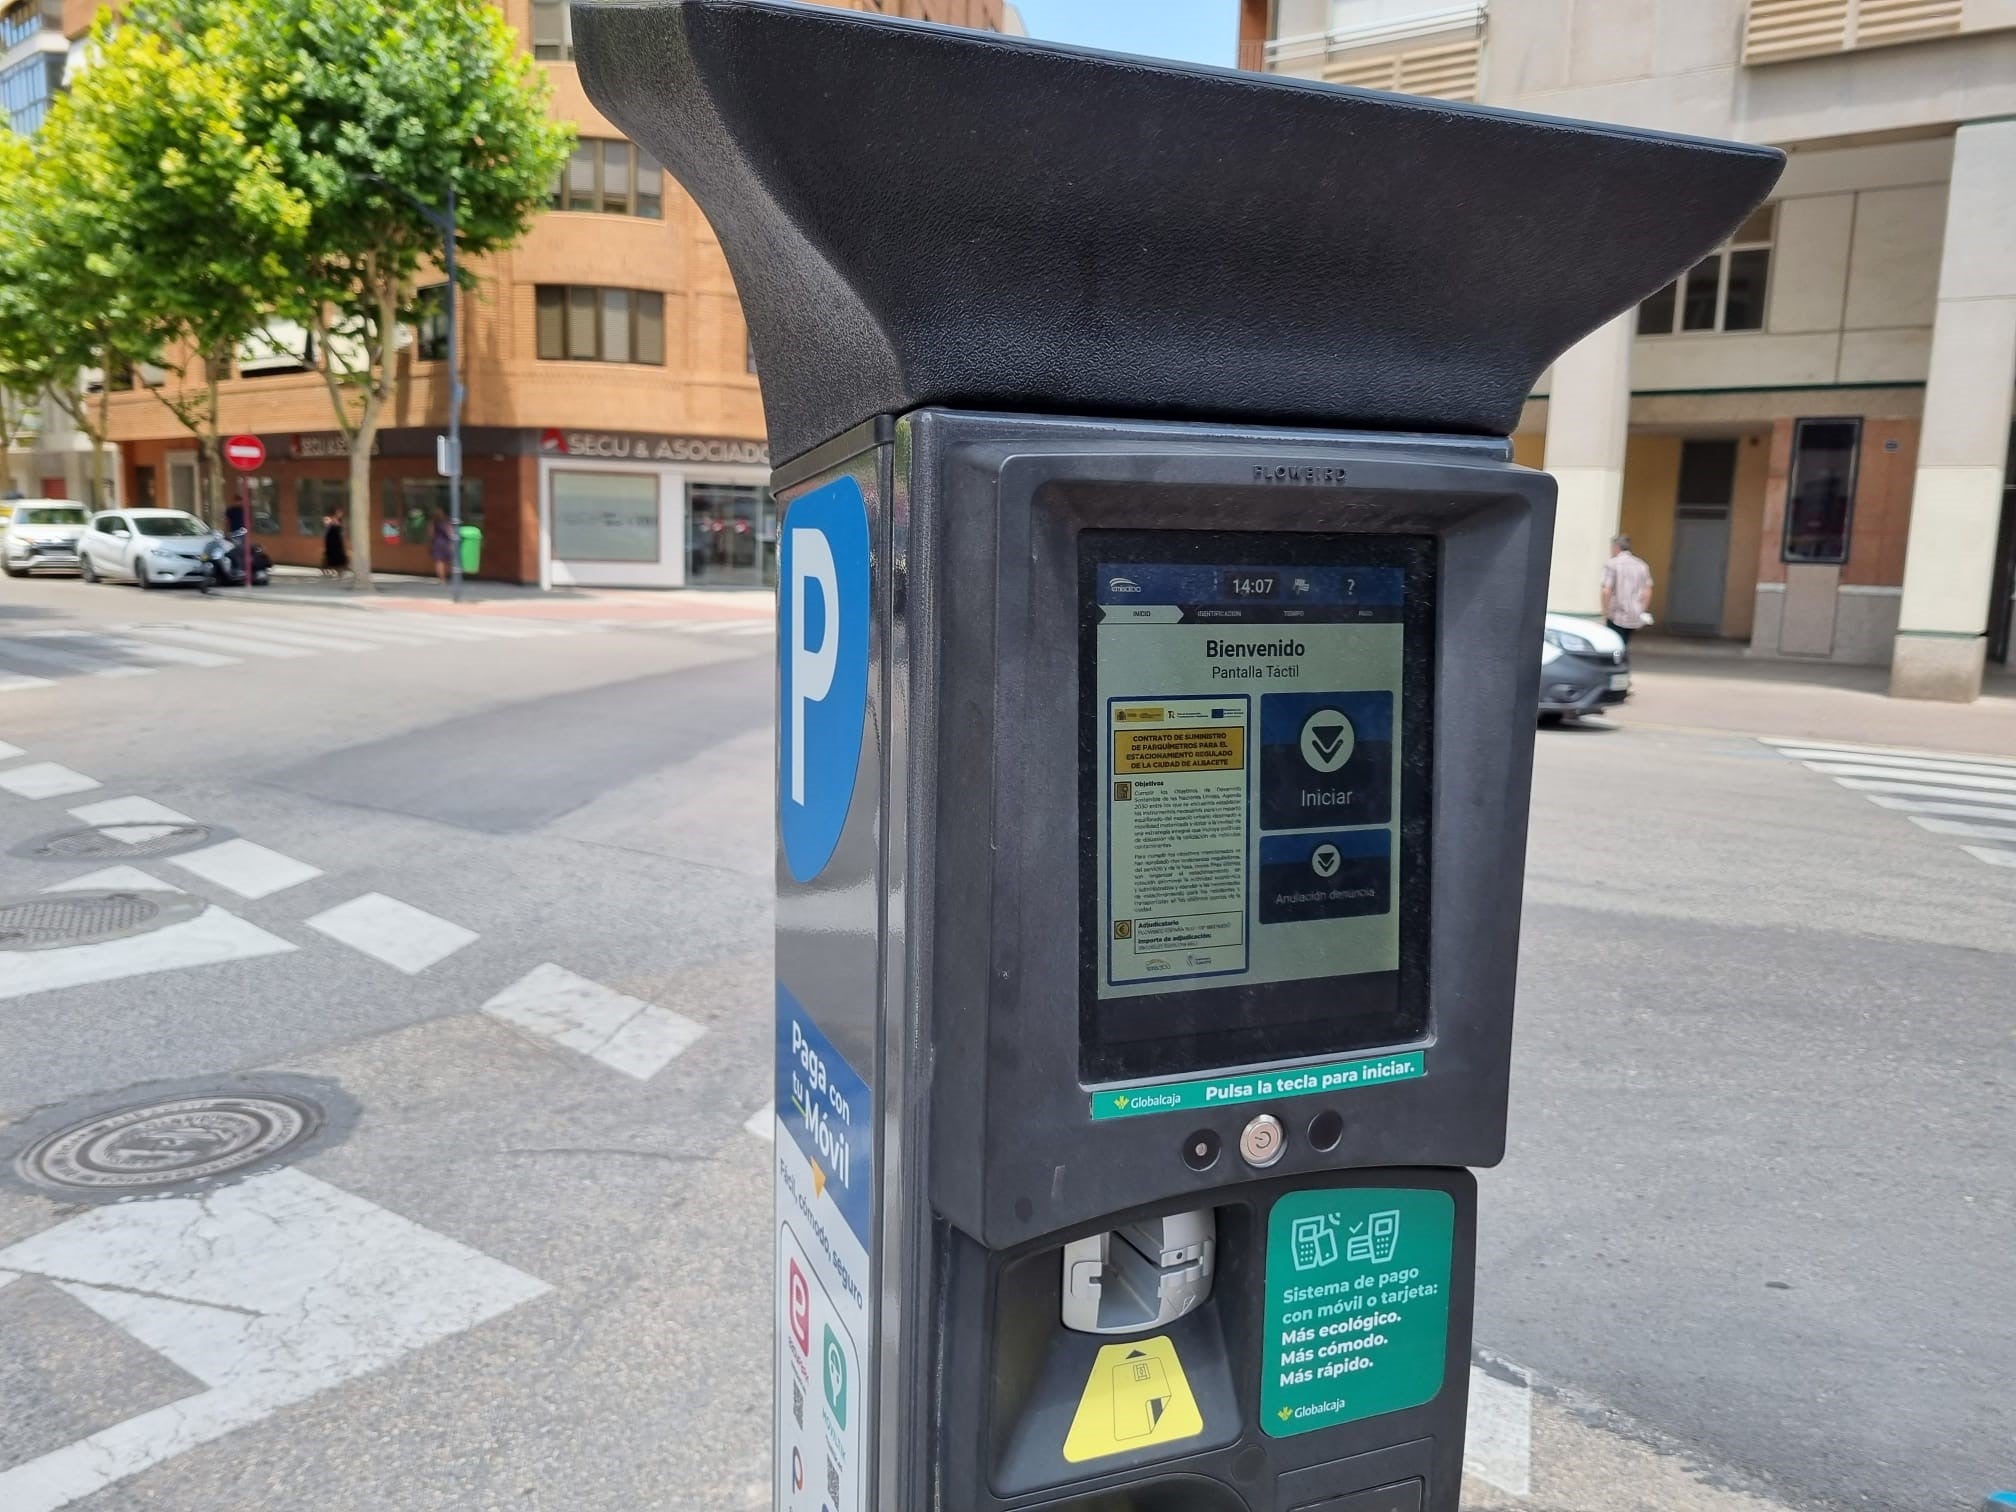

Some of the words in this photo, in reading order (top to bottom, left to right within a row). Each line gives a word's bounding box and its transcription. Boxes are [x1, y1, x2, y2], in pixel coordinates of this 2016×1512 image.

[567, 433, 630, 458] SECU
[633, 438, 650, 459] &
[1232, 578, 1274, 595] 14:07
[1206, 639, 1305, 658] Bienvenido
[792, 528, 840, 807] P
[1212, 665, 1263, 680] Pantalla
[1266, 664, 1300, 678] Táctil
[1126, 752, 1194, 761] ESTACIONAMIENTO
[1195, 750, 1233, 758] REGULADO
[1192, 759, 1229, 767] ALBACETE
[1301, 788, 1353, 807] Iniciar
[792, 1019, 827, 1095] Paga
[829, 1083, 850, 1126] con
[1205, 1086, 1253, 1101] Pulsa
[1257, 1081, 1274, 1095] la
[1276, 1076, 1318, 1092] tecla
[1321, 1071, 1359, 1090] para
[1362, 1060, 1416, 1081] iniciar.
[1130, 1092, 1181, 1110] Globalcaja
[792, 1070, 804, 1101] tu
[804, 1089, 849, 1190] Móvil
[798, 1193, 832, 1262] cómodo,
[832, 1250, 863, 1311] seguro
[1283, 1281, 1350, 1304] Sistema
[1354, 1275, 1375, 1290] de
[1378, 1268, 1420, 1290] pago
[1282, 1308, 1313, 1325] con
[1317, 1295, 1363, 1318] móvil
[1366, 1296, 1377, 1308] o
[1381, 1284, 1438, 1304] tarjeta:
[1281, 1327, 1315, 1346] Más
[1319, 1311, 1402, 1338] ecológico.
[1280, 1347, 1314, 1367] Más
[1317, 1333, 1388, 1358] cómodo.
[1279, 1368, 1313, 1387] Más
[1316, 1356, 1374, 1381] rápido.
[1294, 1398, 1346, 1419] Globalcaja
